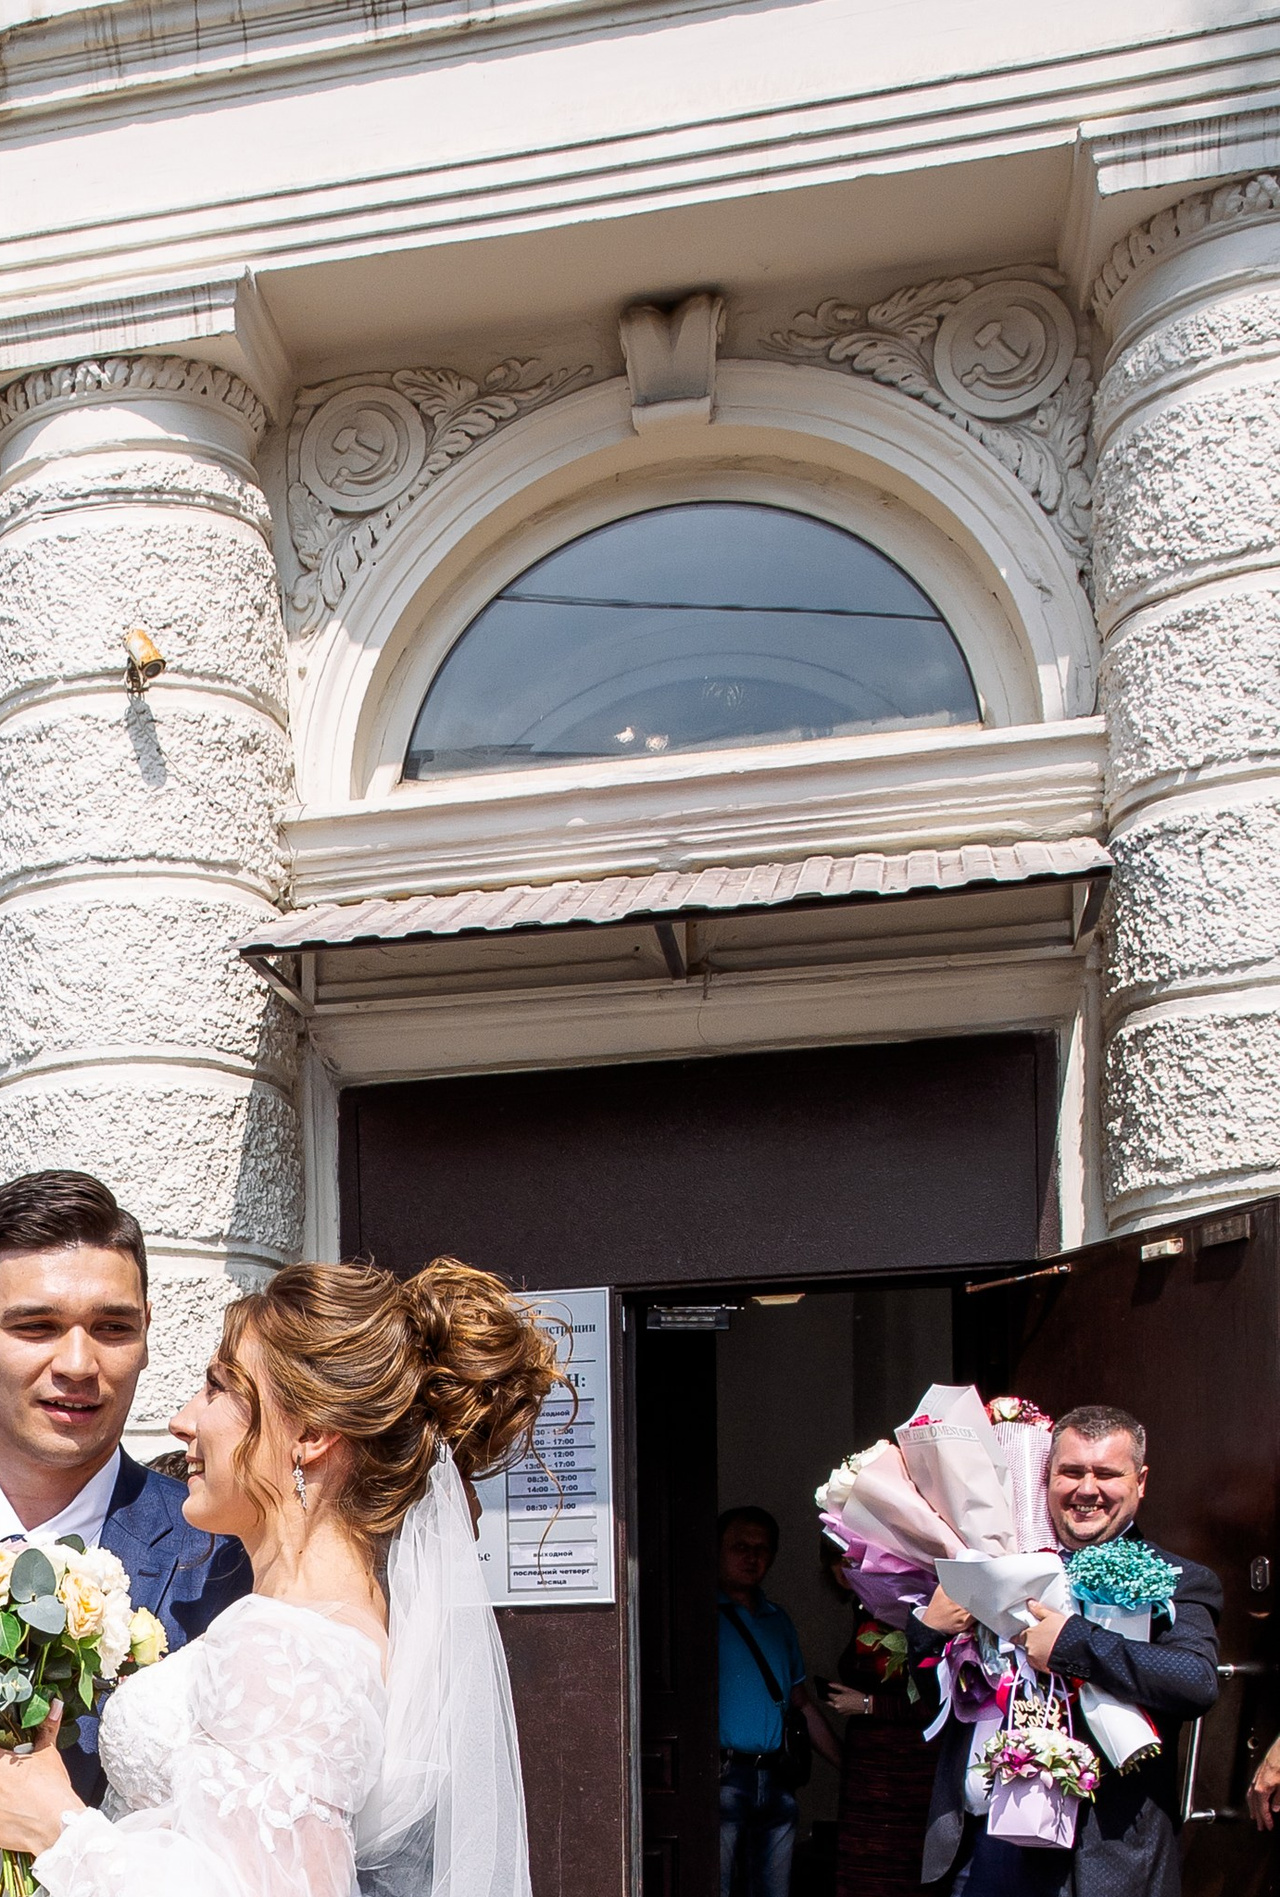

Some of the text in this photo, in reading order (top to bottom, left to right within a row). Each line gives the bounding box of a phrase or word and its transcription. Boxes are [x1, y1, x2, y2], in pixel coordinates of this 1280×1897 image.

[552, 1438, 574, 1446] 17:00
[553, 1450, 575, 1458] 12:00
[554, 1460, 576, 1468] 17:00
[527, 1475, 549, 1483] 08:30
[526, 1503, 548, 1511] 08:30
[559, 1568, 591, 1576] четверг
